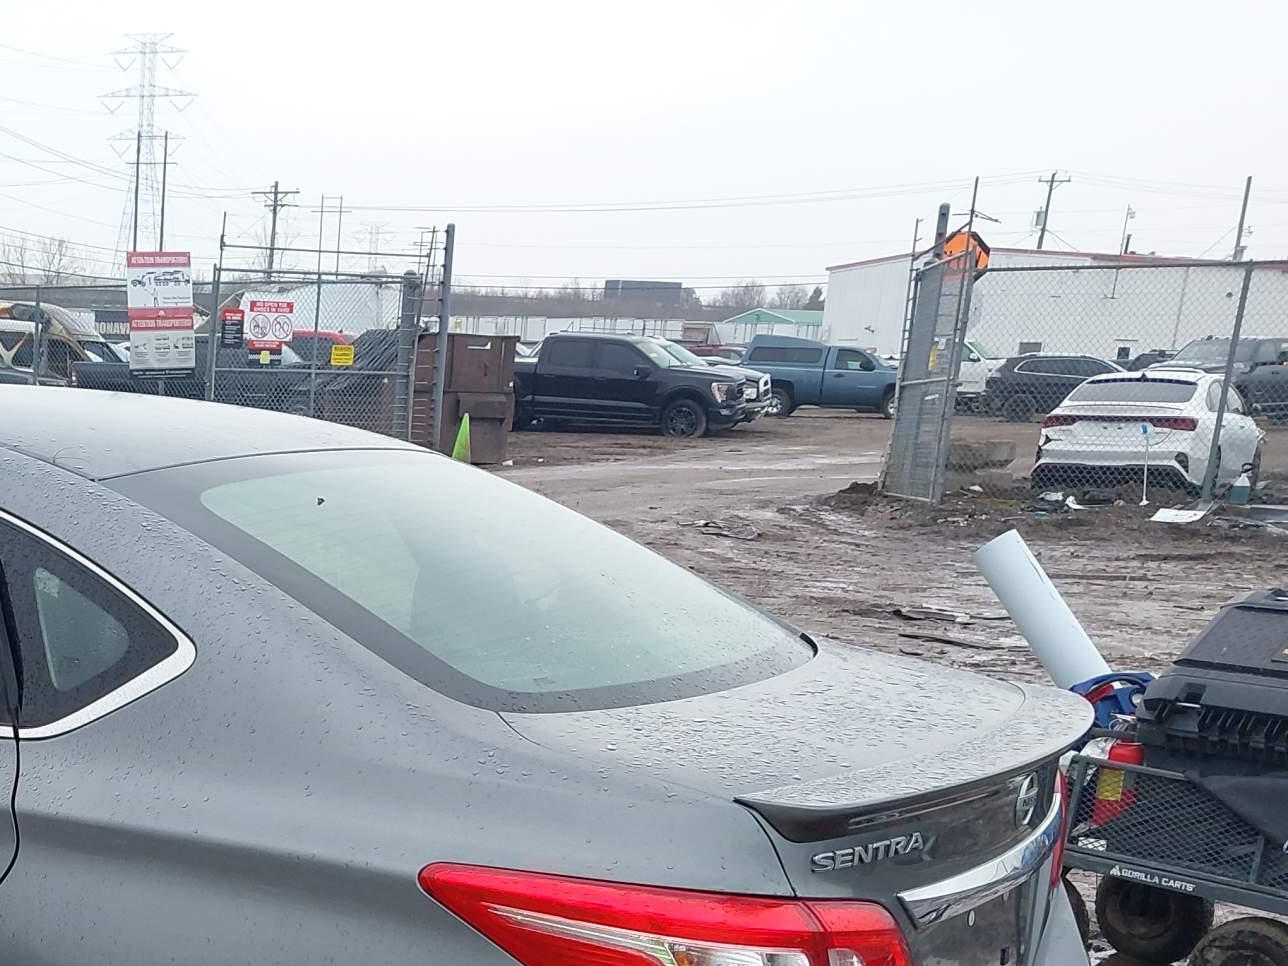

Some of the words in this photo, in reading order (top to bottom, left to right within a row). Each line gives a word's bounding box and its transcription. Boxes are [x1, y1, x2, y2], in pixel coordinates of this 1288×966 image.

[811, 831, 925, 872] SENTRA
[1121, 868, 1160, 884] GORILLA
[1161, 877, 1193, 892] CARTS
